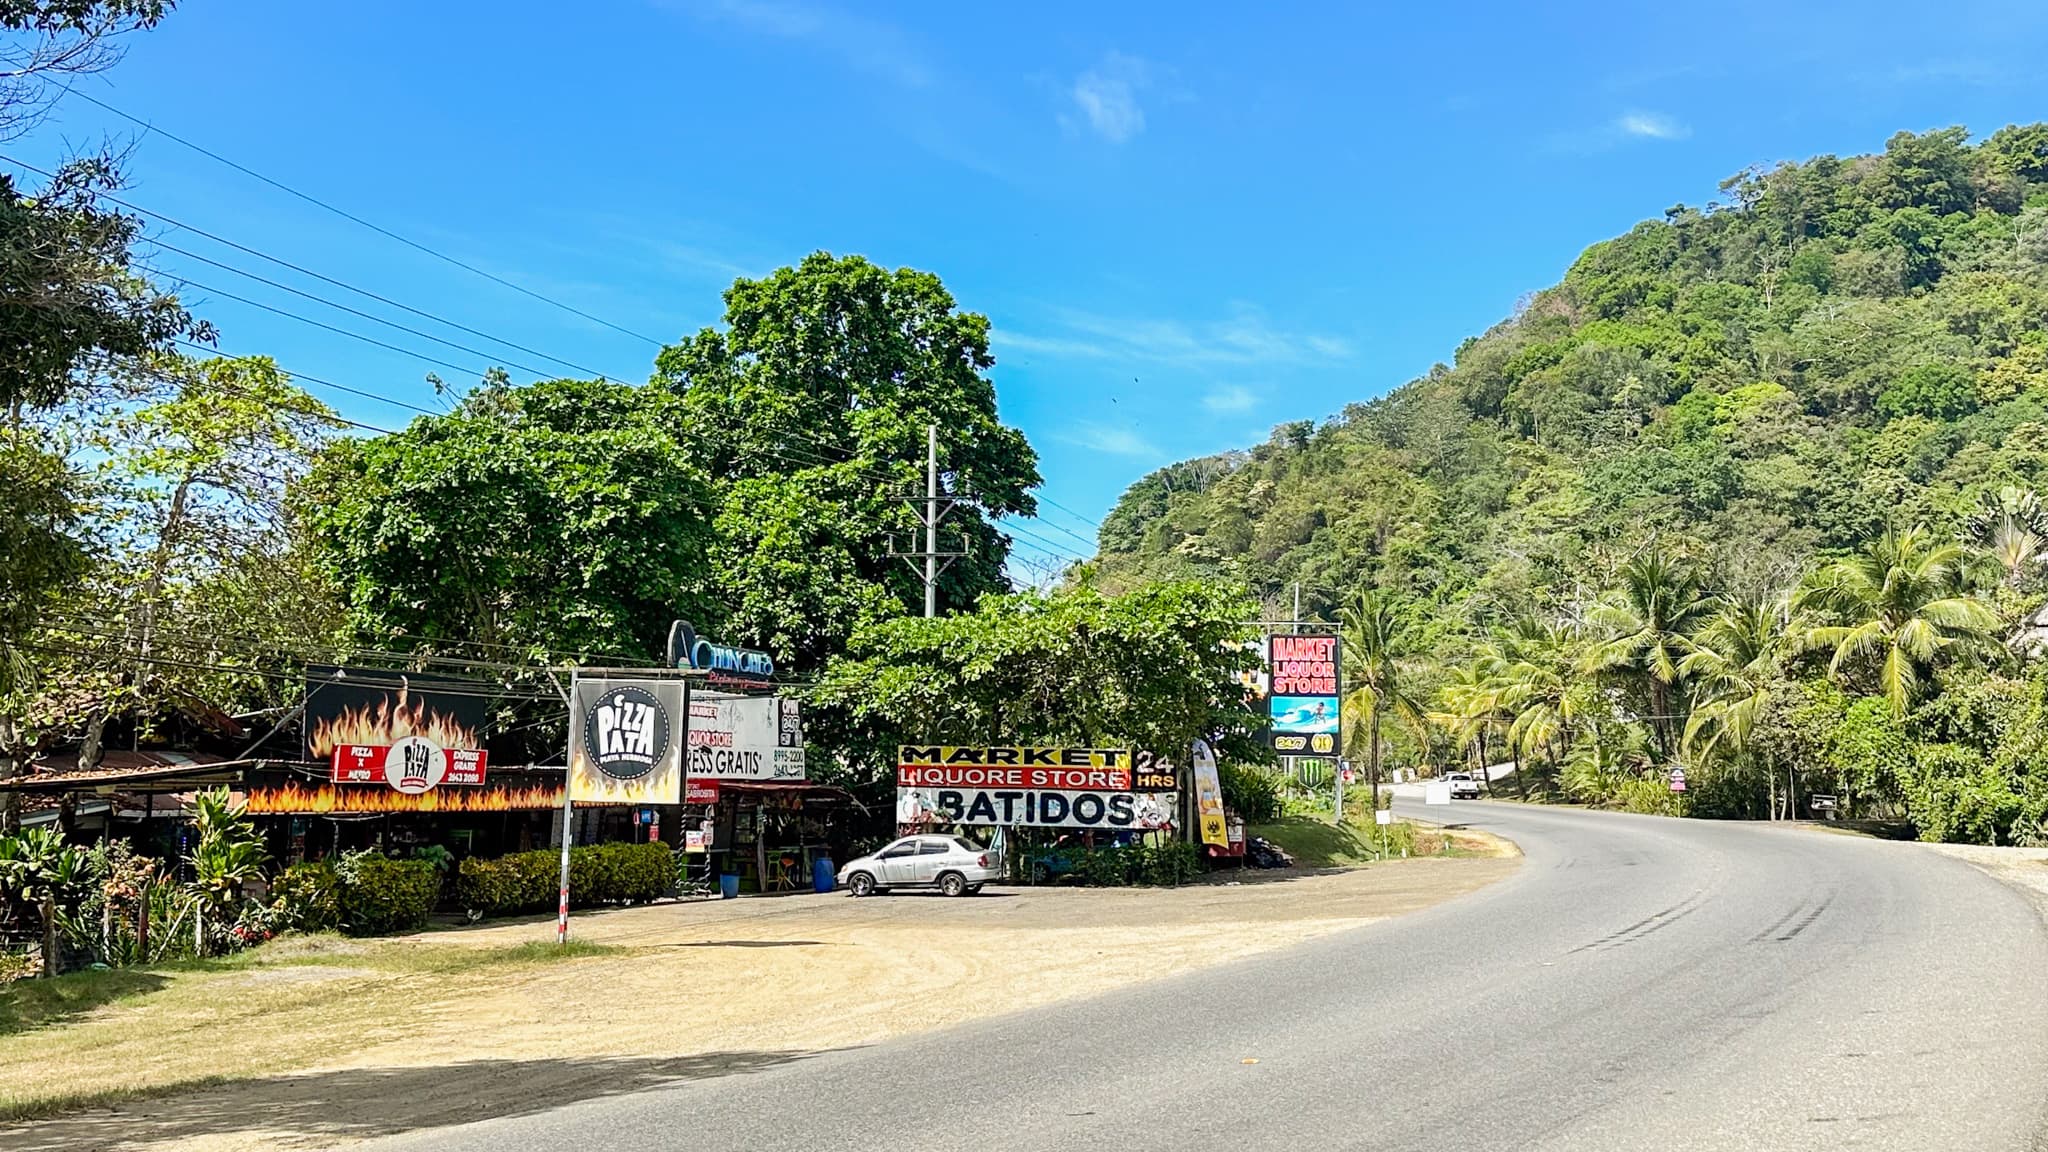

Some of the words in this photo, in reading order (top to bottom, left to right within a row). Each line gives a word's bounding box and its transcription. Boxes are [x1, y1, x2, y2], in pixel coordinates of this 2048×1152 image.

[1273, 638, 1335, 661] MARKET
[1274, 662, 1335, 677] LIQUOR
[1274, 678, 1337, 693] STORE
[711, 732, 732, 747] STORE
[1276, 737, 1306, 749] 24/7
[901, 748, 1127, 767] MARKET
[1136, 750, 1175, 774] 24
[900, 768, 1022, 785] LIQUORE
[1031, 770, 1125, 788] STORE
[1137, 775, 1175, 788] HRS
[938, 791, 1135, 826] BATIDOS
